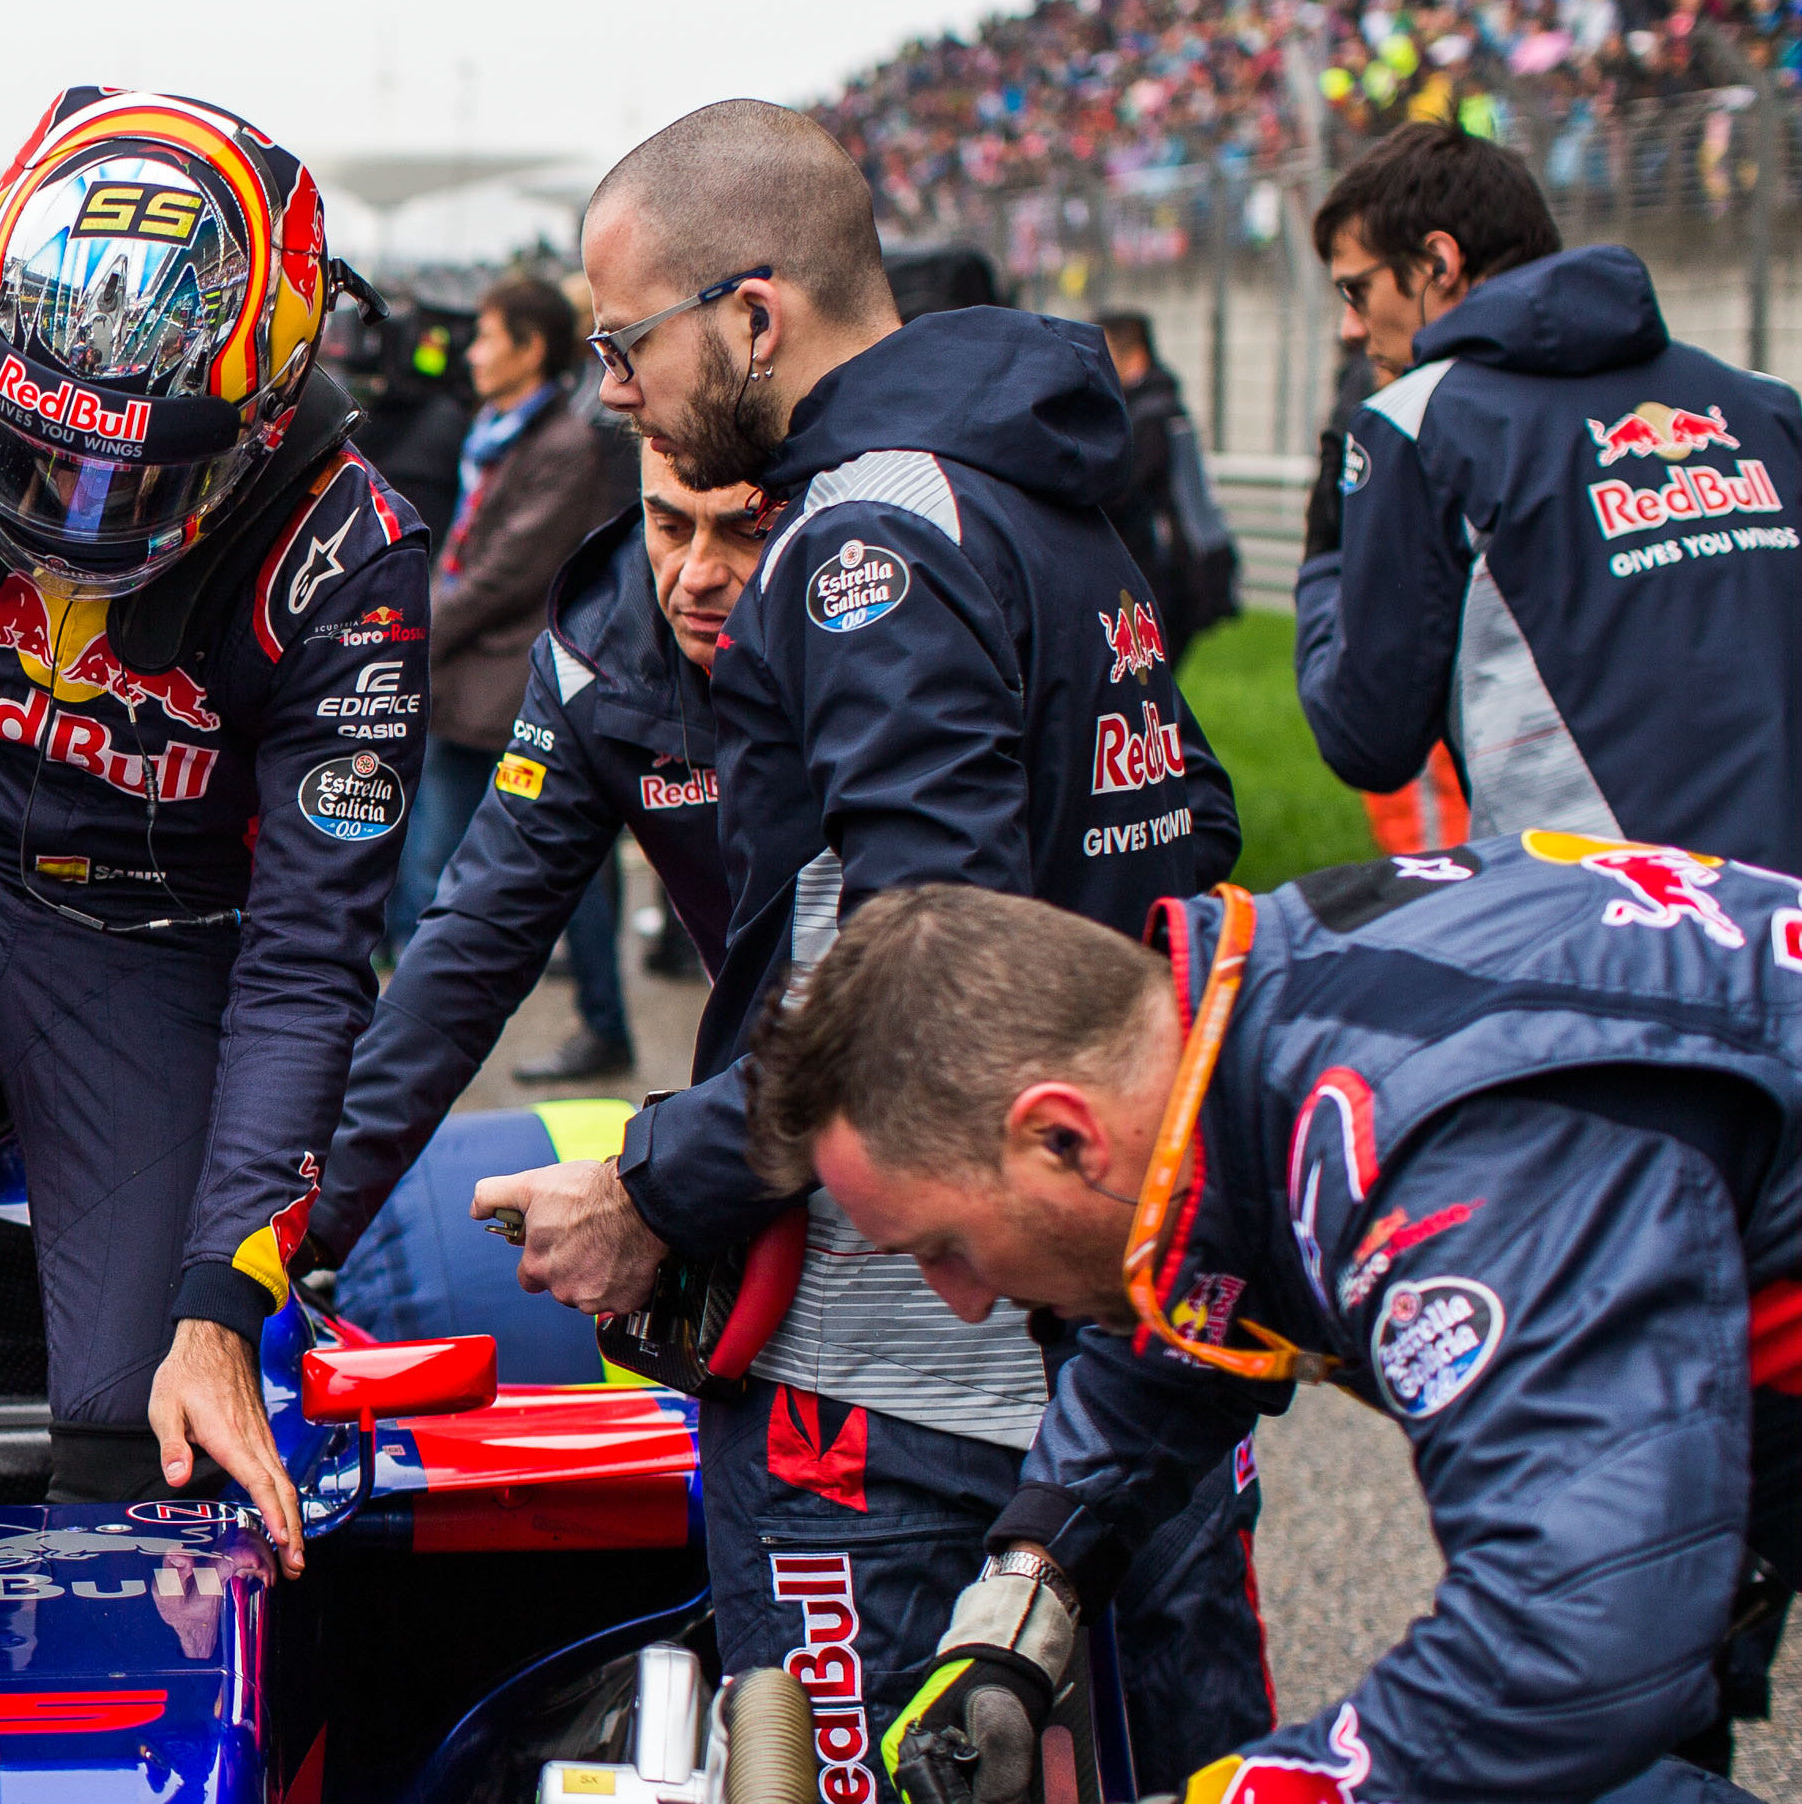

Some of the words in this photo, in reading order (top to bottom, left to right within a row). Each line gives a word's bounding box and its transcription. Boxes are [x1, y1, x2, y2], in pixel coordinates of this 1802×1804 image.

[40, 419, 75, 443] YOU
[84, 435, 143, 458] WINGS
[1609, 539, 1683, 578] GIVES
[1679, 530, 1733, 559] YOU
[1730, 526, 1800, 551] WINGS
[817, 560, 895, 598] Estrella
[824, 582, 892, 618] Galicia
[341, 627, 384, 647] Toro
[316, 694, 421, 717] EDIFICE
[337, 722, 407, 740] CASIO
[316, 770, 393, 801] Estrella
[317, 792, 386, 824] Galicia
[1083, 821, 1147, 857] GIVES
